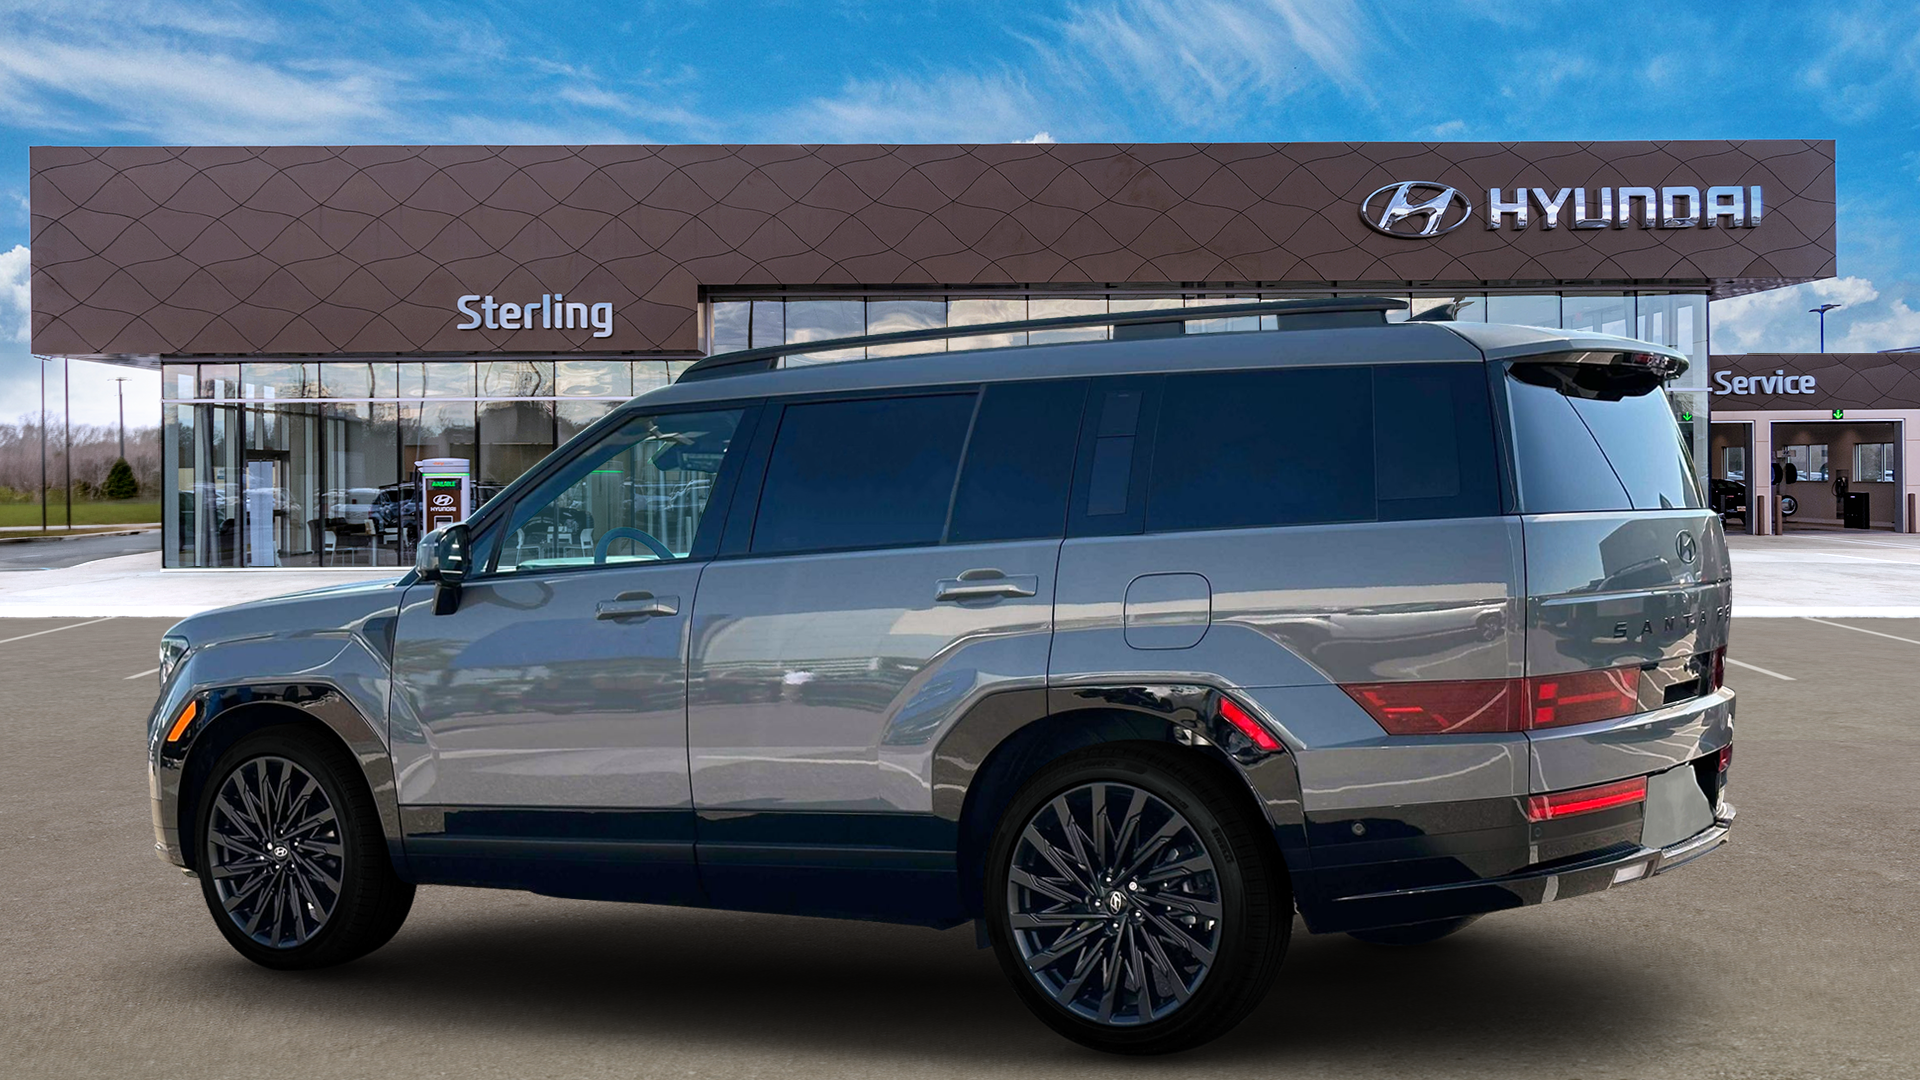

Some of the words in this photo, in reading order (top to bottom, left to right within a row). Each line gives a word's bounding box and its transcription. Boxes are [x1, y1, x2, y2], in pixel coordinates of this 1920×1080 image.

[1486, 185, 1762, 230] HYUNDAI
[456, 293, 614, 338] Sterling
[1713, 369, 1816, 395] Service
[1613, 610, 1707, 639] SANTA
